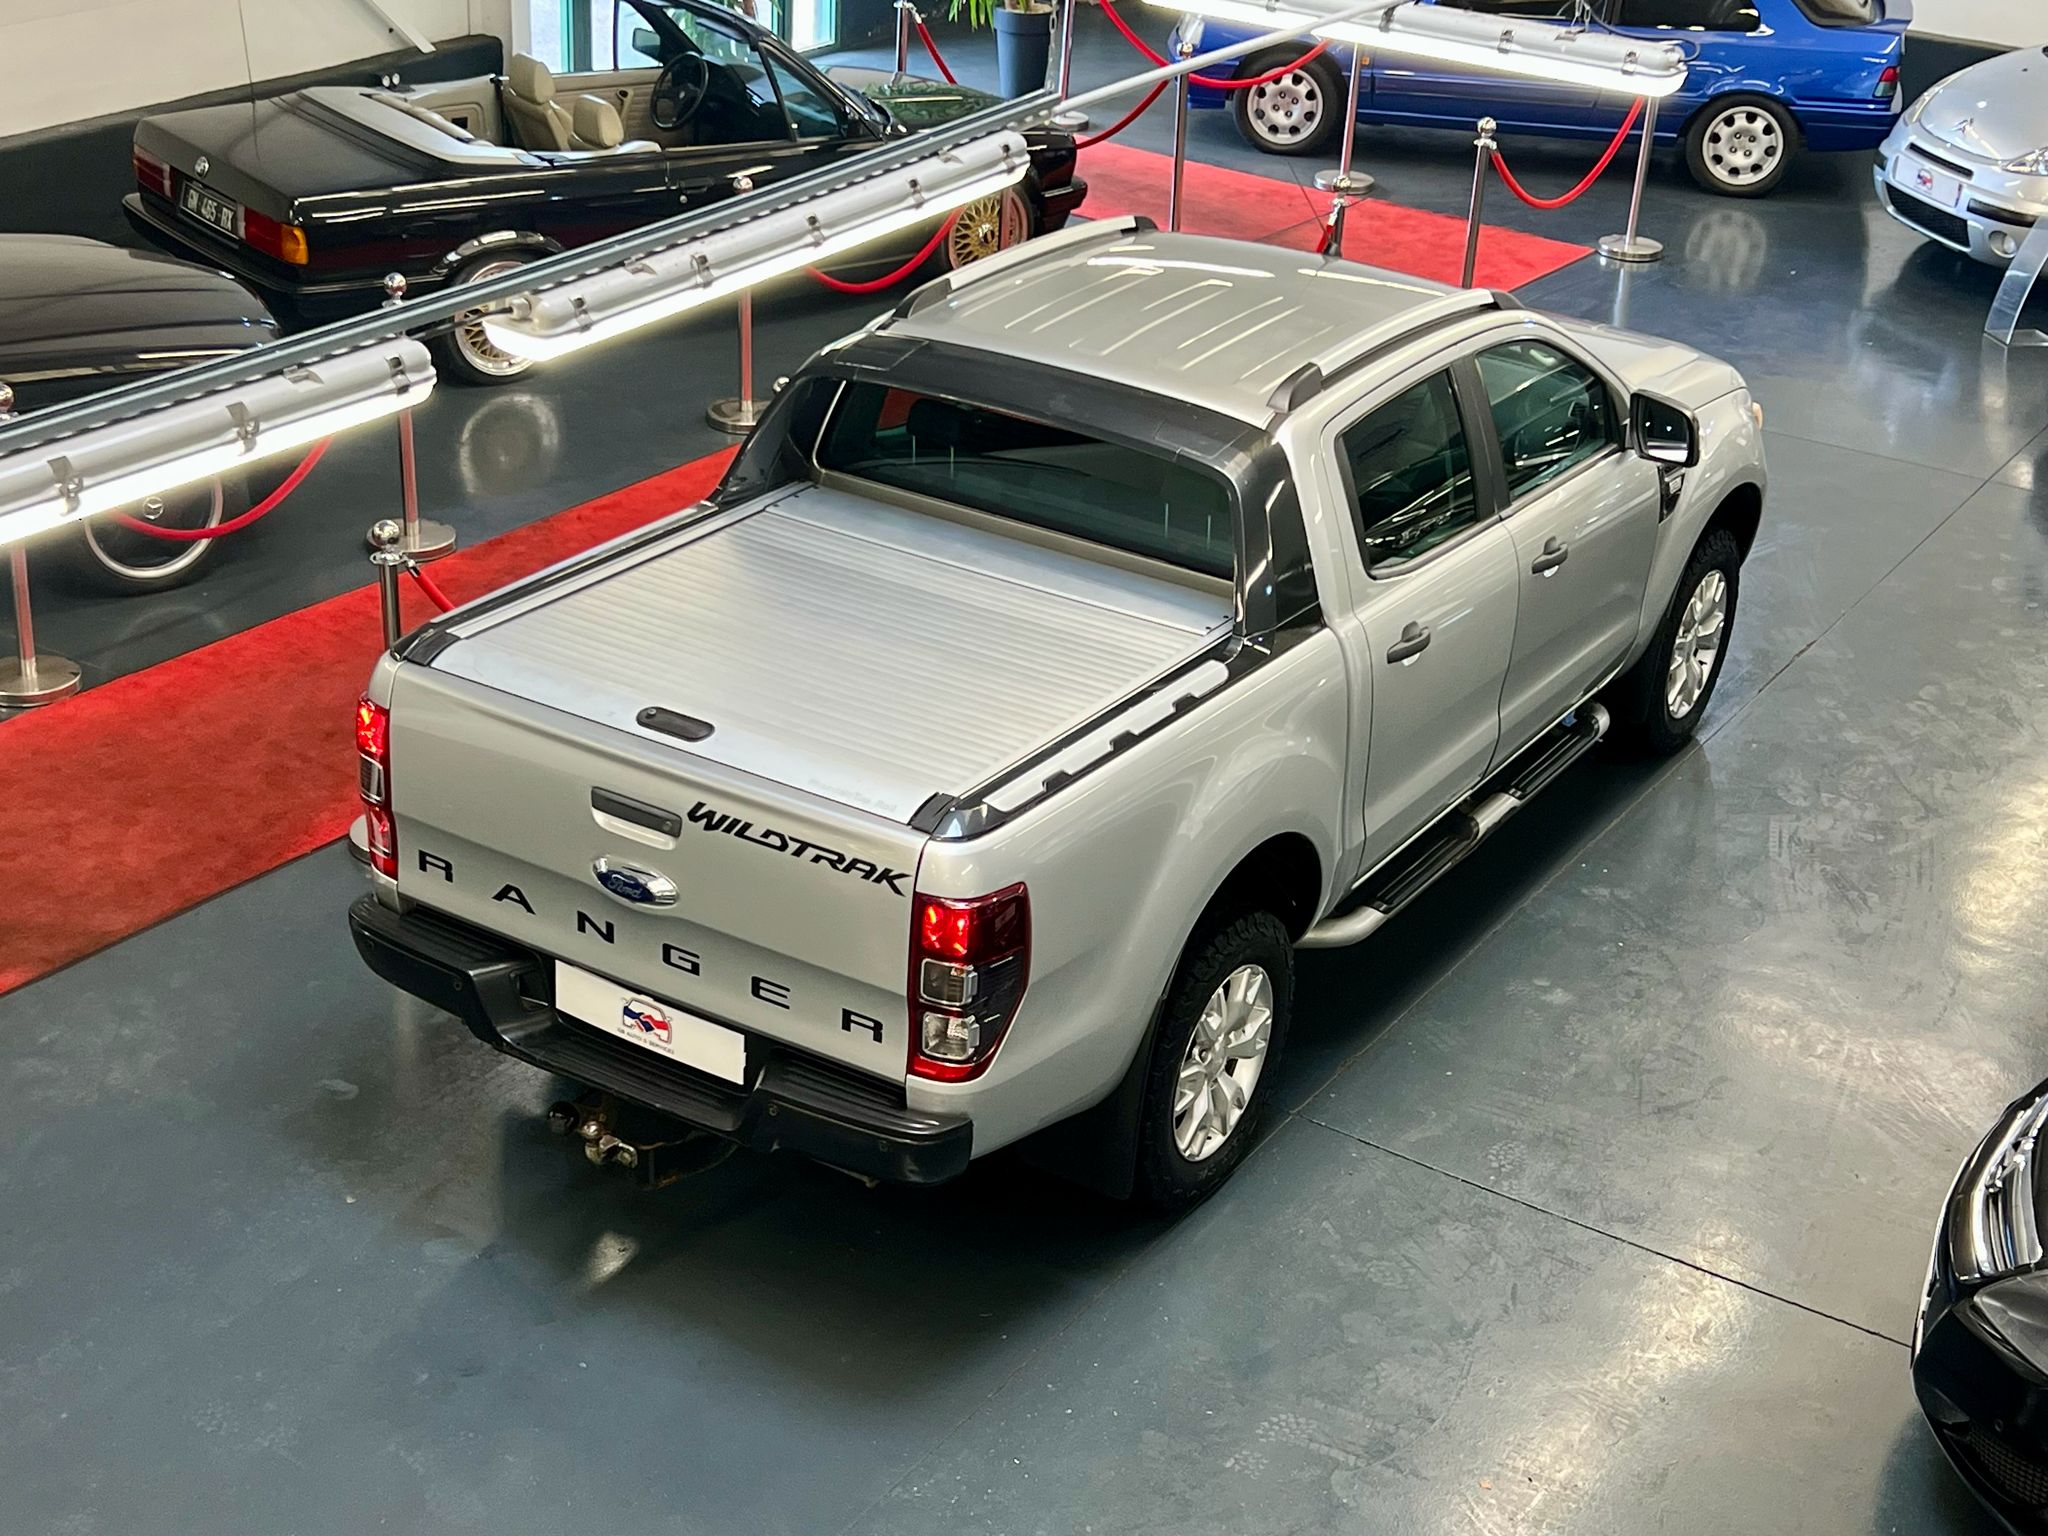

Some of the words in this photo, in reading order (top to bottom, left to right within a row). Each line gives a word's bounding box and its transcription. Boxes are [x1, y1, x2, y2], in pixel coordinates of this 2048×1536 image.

[607, 873, 643, 899] Ford
[687, 801, 912, 897] WILDTRAK
[418, 849, 884, 1043] RANGER
